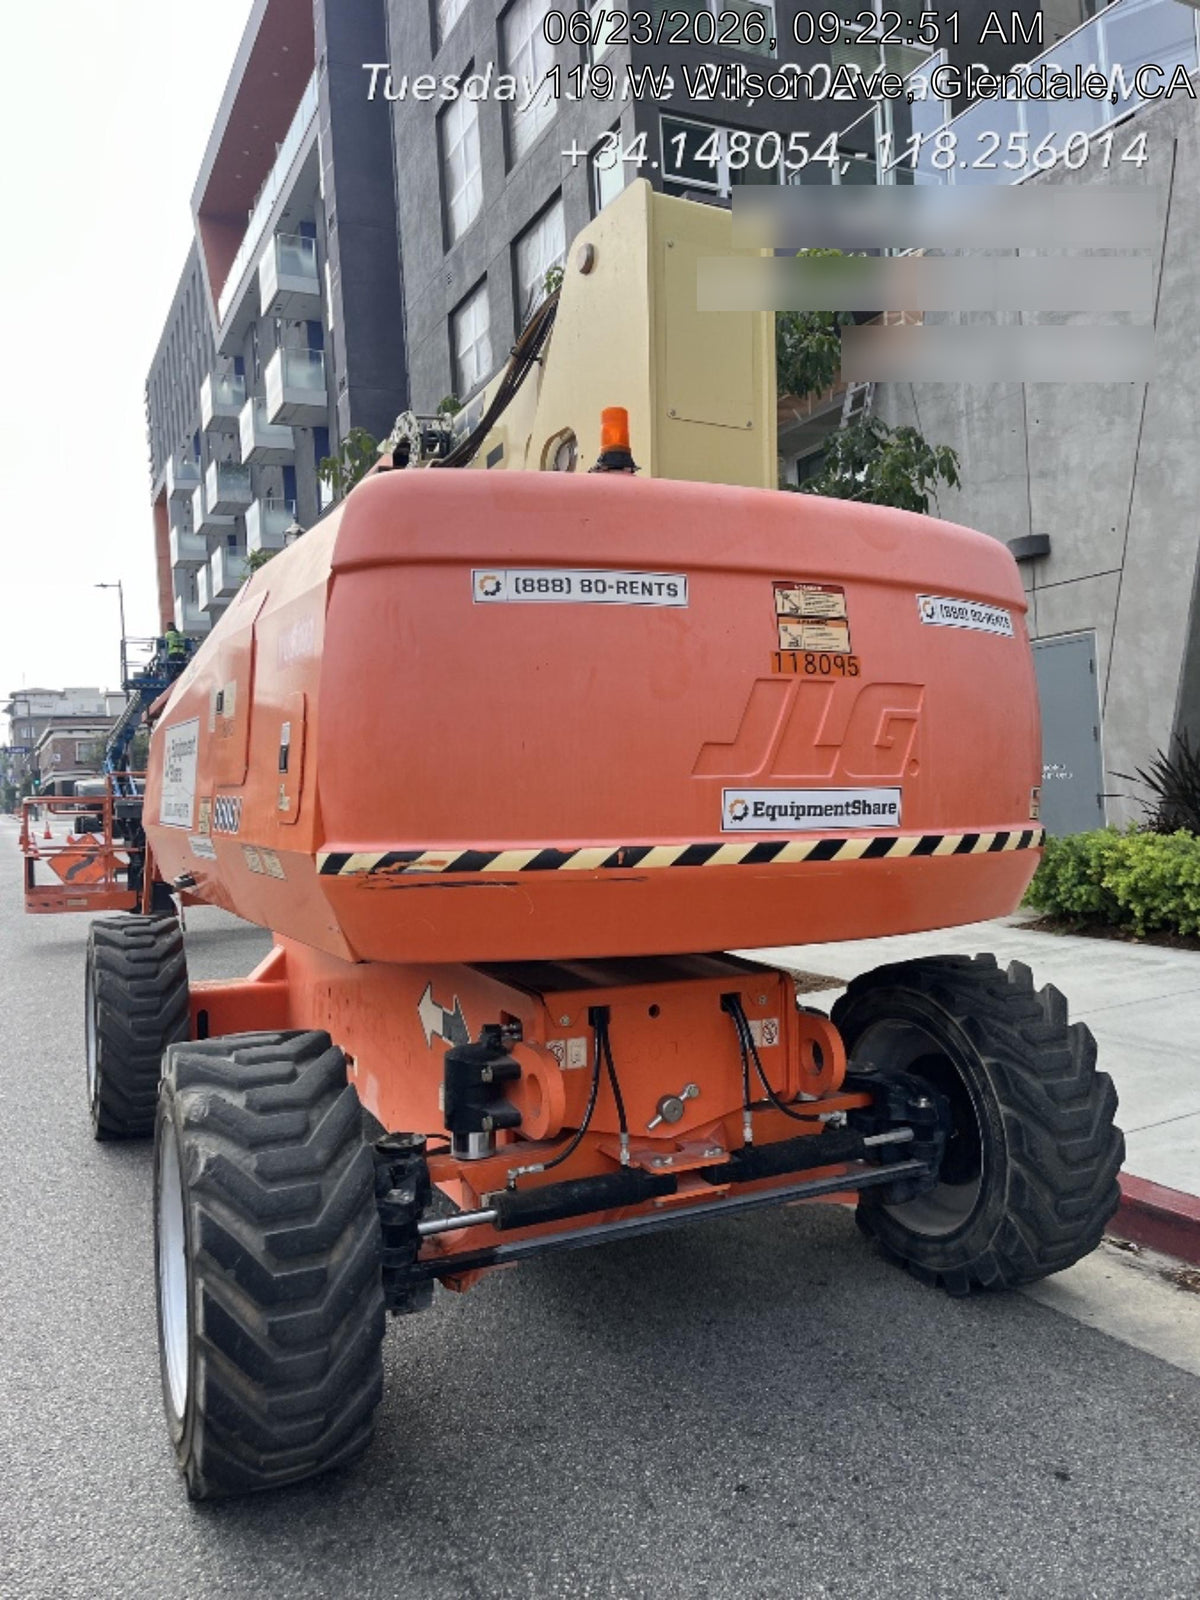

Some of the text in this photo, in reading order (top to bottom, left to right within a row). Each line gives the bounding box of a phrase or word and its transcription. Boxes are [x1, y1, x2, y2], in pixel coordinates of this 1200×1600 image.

[514, 577, 571, 594] (888)
[774, 652, 859, 677] 118095
[752, 800, 897, 822] EquipmentShare
